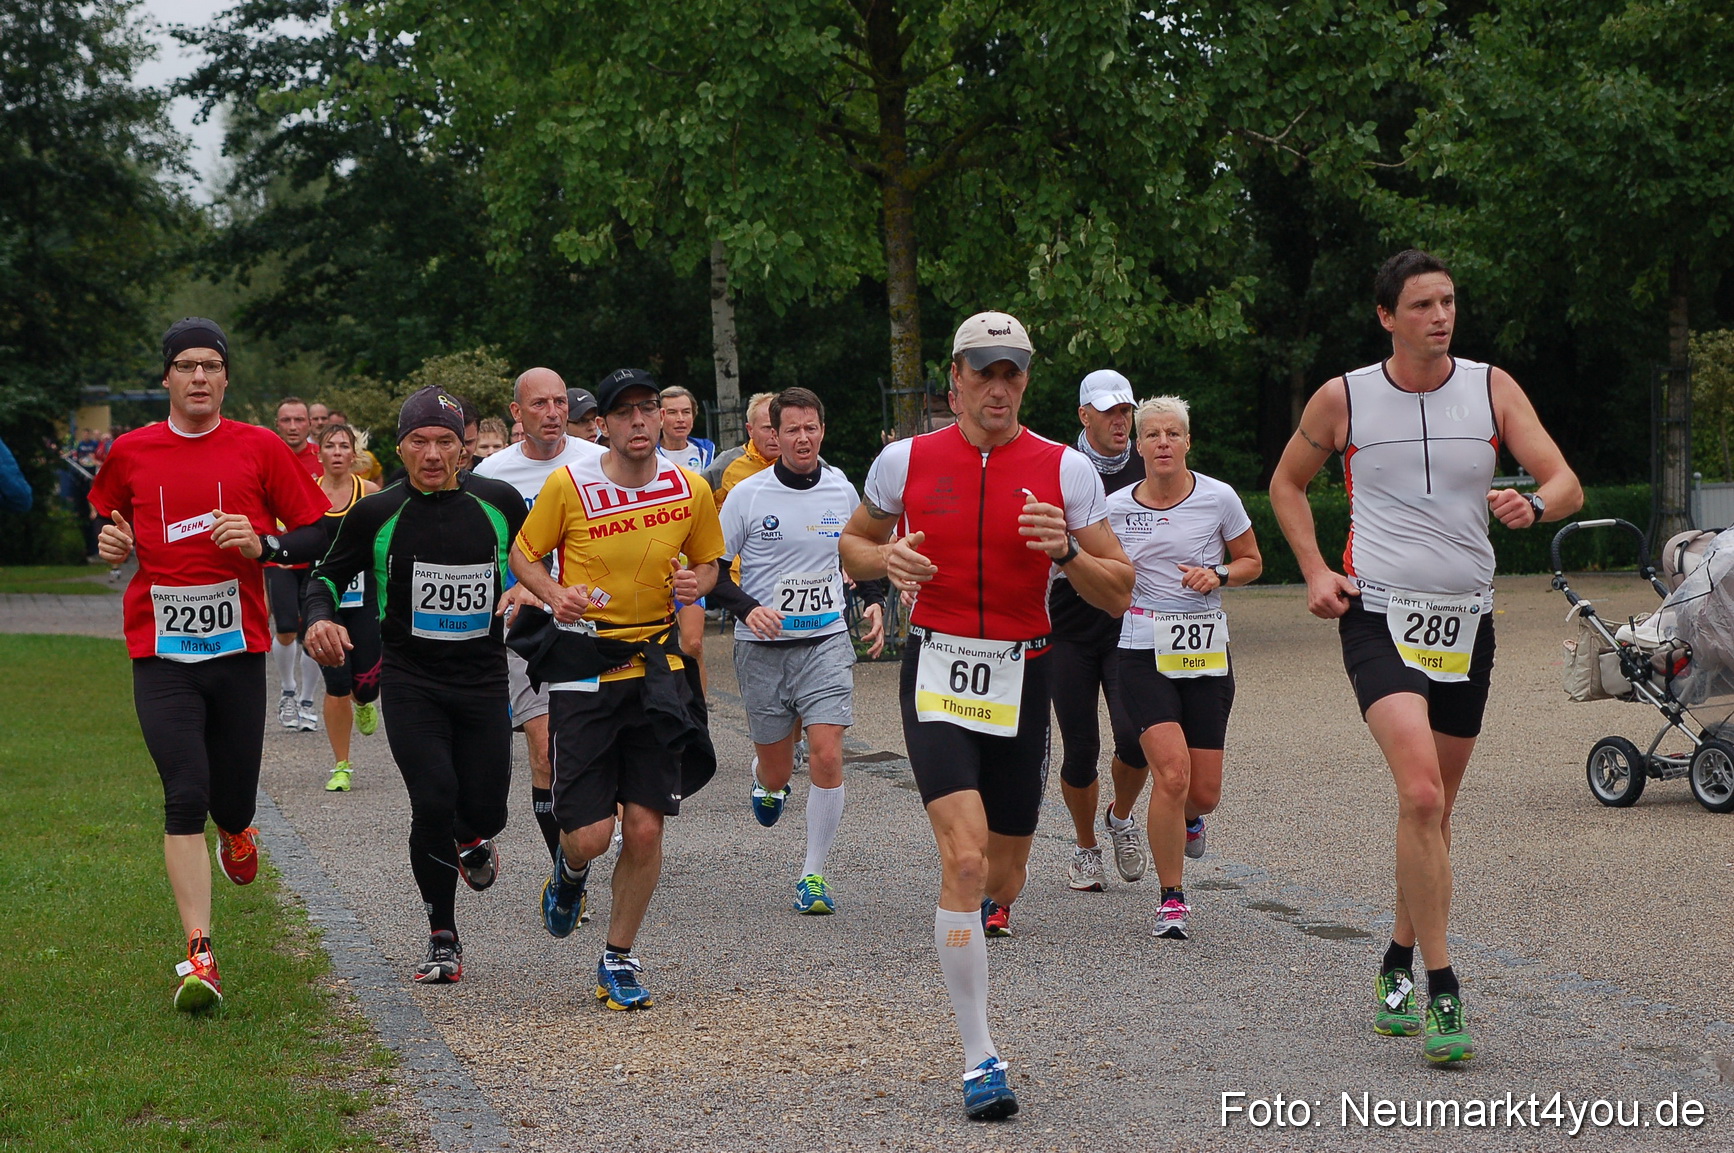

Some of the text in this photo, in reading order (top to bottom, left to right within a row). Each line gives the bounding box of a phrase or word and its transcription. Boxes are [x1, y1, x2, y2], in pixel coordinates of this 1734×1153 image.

[181, 520, 204, 533] DEHN
[588, 506, 692, 540] MAX BÖGL
[415, 570, 443, 580] PARTL
[153, 591, 224, 602] PARTL Neumarkt
[420, 582, 487, 612] 2953
[780, 586, 833, 612] 2754
[1391, 596, 1467, 613] PARTL Neumarkt
[163, 601, 233, 633] 2290
[439, 618, 467, 629] klaus
[793, 617, 822, 628] Daniel
[1155, 613, 1215, 622] PARTL Neumarkt
[1171, 624, 1215, 650] 287
[1403, 612, 1461, 647] 289
[181, 640, 221, 652] Markus
[923, 640, 955, 654] PARTL
[949, 660, 991, 696] 60
[942, 698, 992, 720] Thomas
